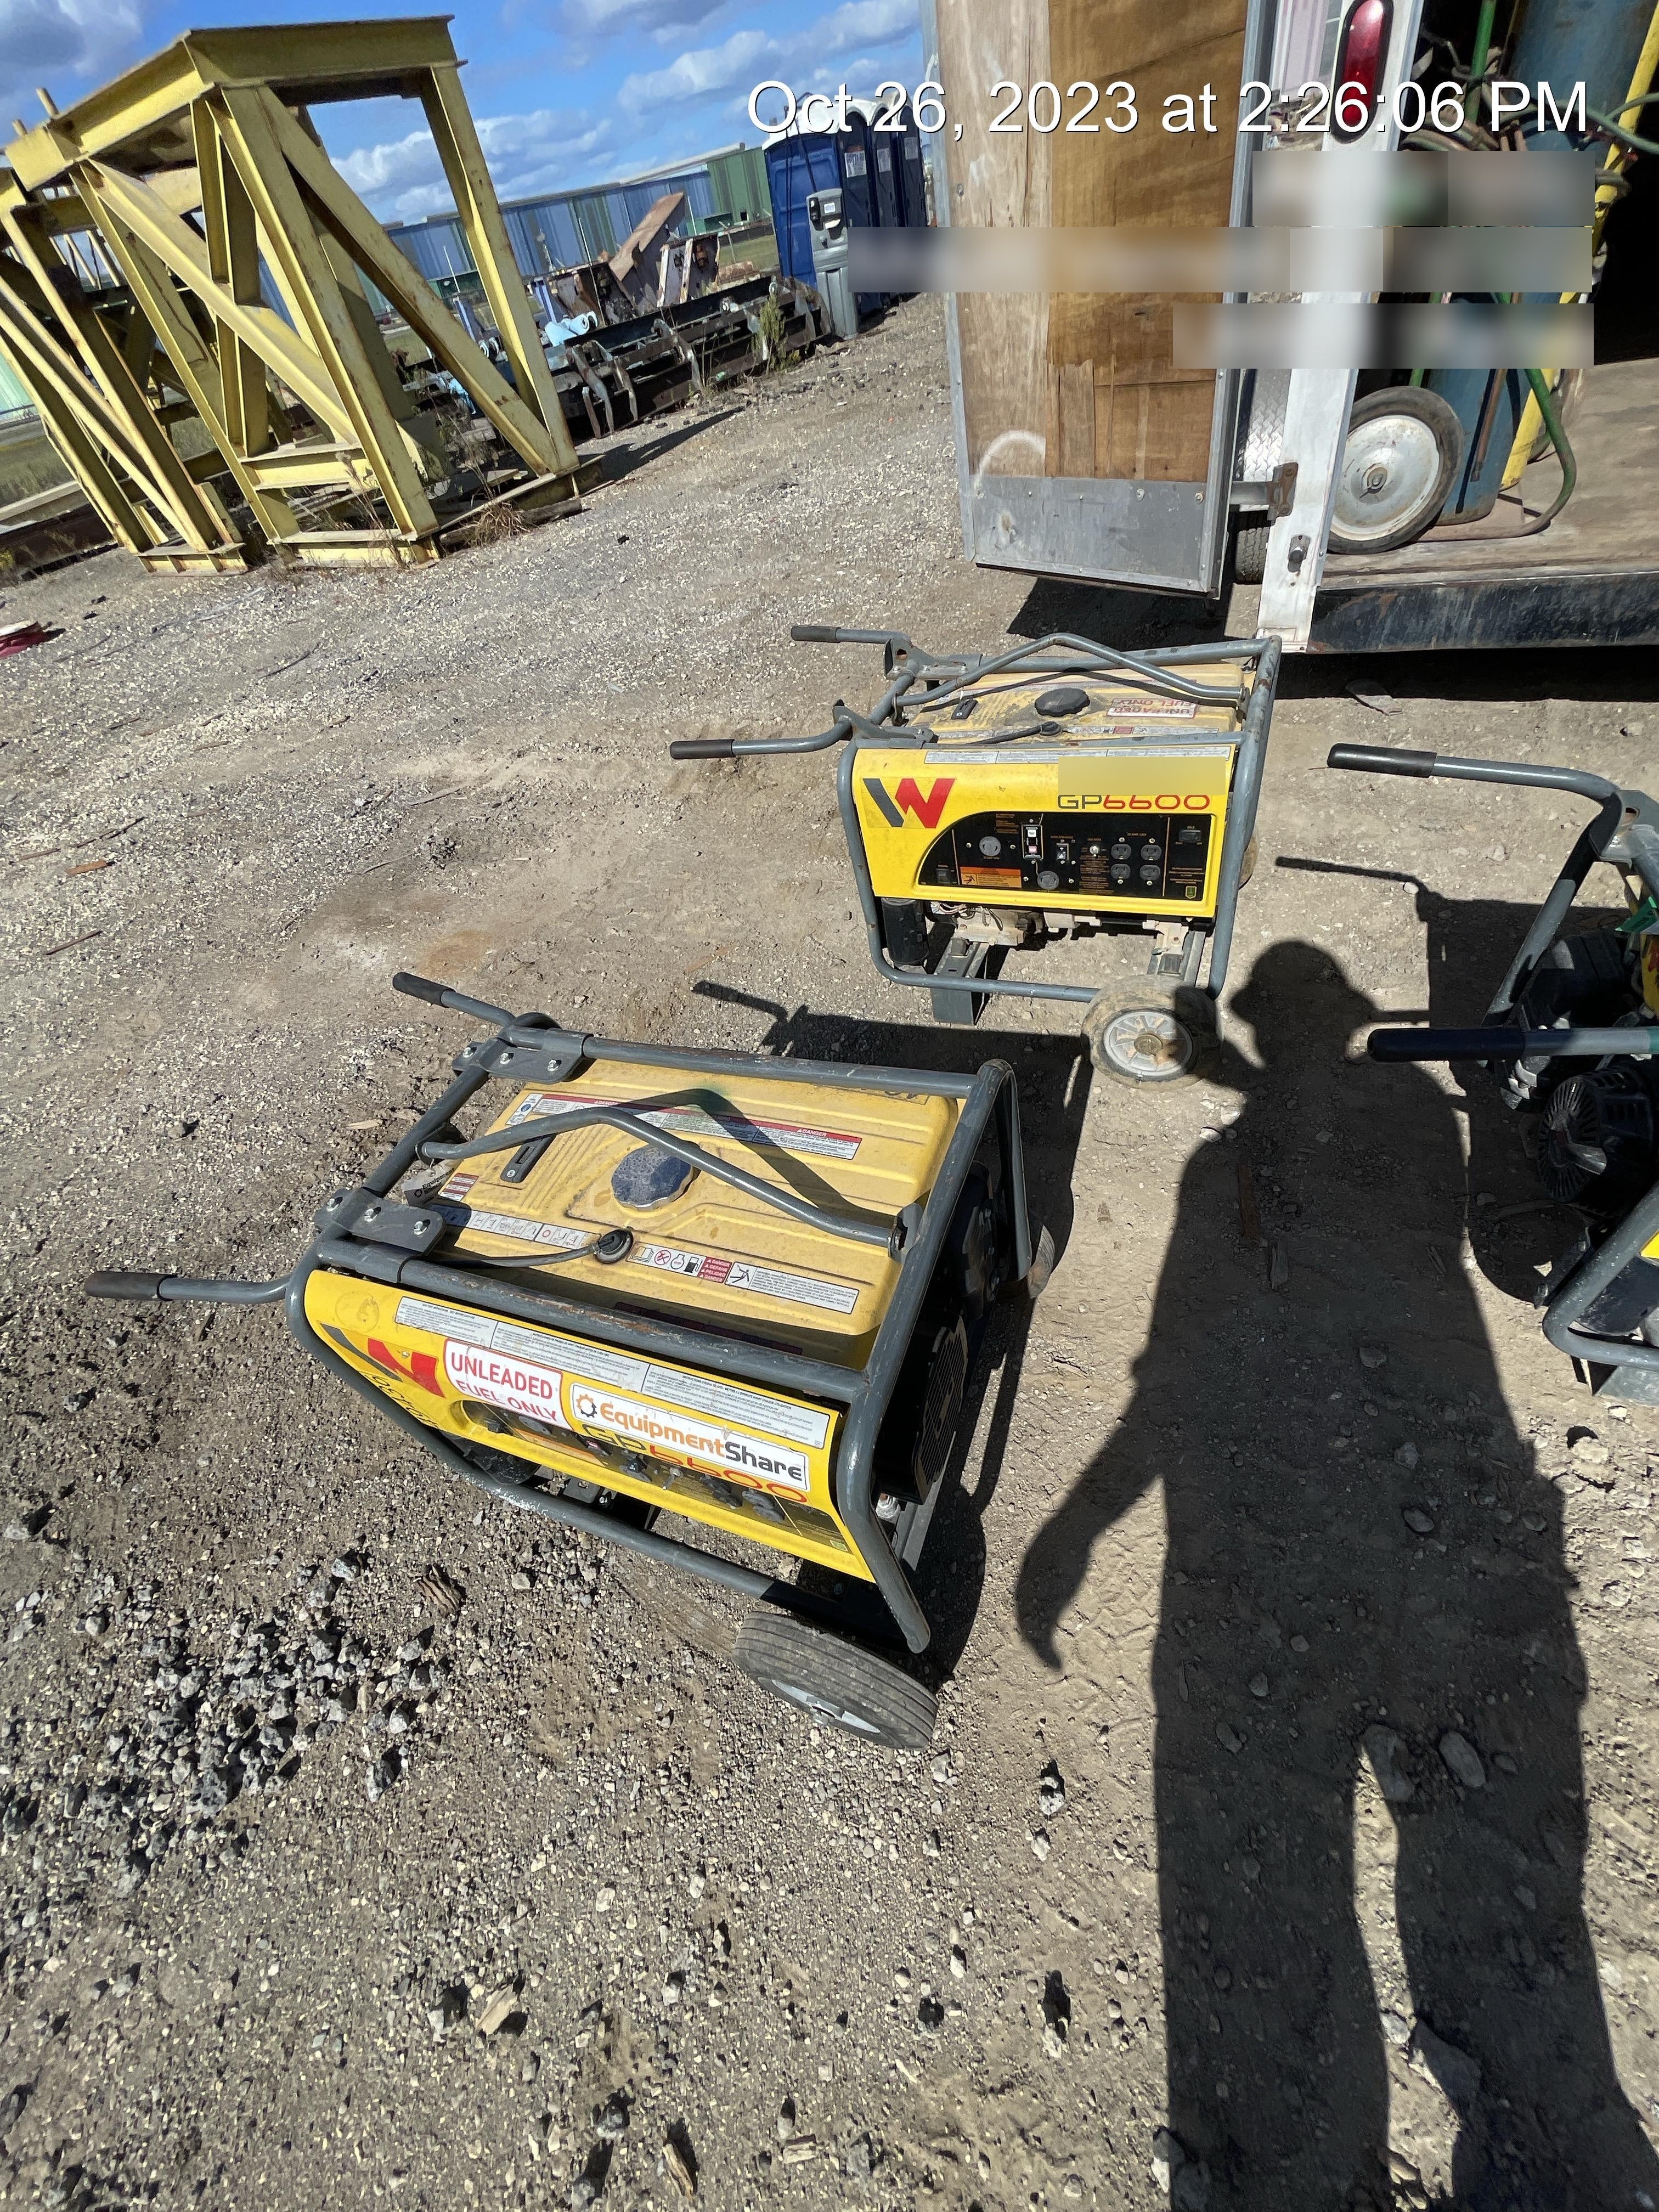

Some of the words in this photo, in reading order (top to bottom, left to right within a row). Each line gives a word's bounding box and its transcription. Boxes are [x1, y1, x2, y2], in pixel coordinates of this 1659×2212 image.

[1057, 794, 1210, 810] GP6600
[802, 1128, 827, 1137] DANGER
[712, 1259, 730, 1267] DANGER
[451, 1351, 553, 1400] UNLEADED
[455, 1379, 506, 1405] FUEL
[507, 1396, 558, 1422] ONLY
[600, 1402, 803, 1481] EquipmentShare
